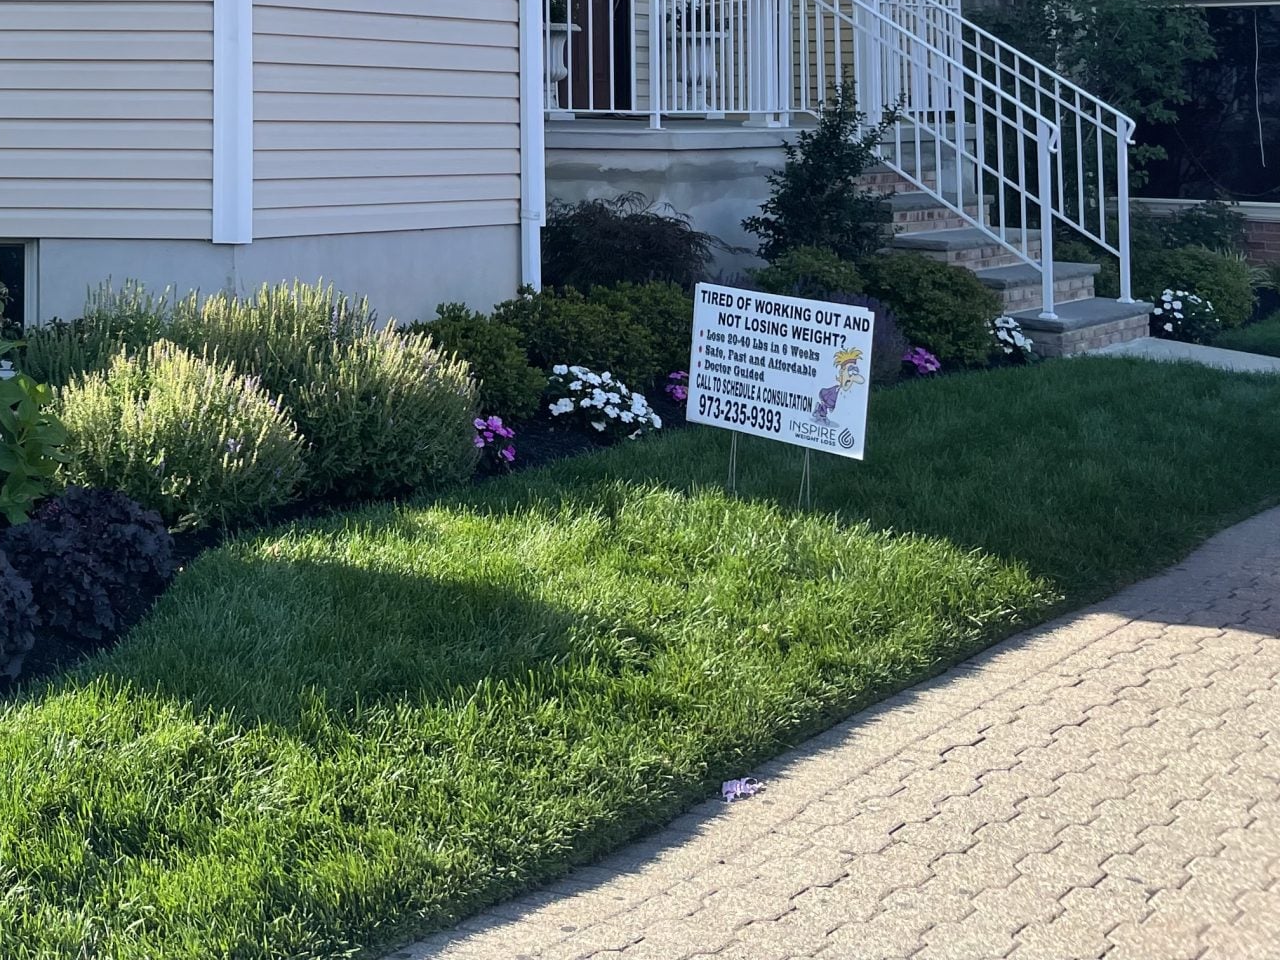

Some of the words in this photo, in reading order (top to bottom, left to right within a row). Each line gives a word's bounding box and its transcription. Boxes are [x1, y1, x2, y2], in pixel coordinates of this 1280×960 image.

[701, 290, 732, 307] TIRED
[737, 296, 751, 310] OF
[755, 299, 811, 321] WORKING
[815, 310, 841, 327] OUT
[843, 316, 870, 332] AND
[707, 330, 725, 343] Lose
[727, 334, 750, 347] 20-40
[753, 338, 767, 351] Lbs
[770, 341, 779, 353] in
[782, 344, 787, 355] 6
[791, 346, 820, 361] Weeks
[718, 312, 741, 328] NOT
[745, 317, 787, 337] LOSING
[792, 325, 846, 348] WEIGHT?
[704, 360, 731, 376] Doctor
[734, 366, 765, 382] Guided
[705, 345, 725, 360] Safe,
[728, 350, 746, 362] Fast
[749, 354, 765, 367] and
[768, 359, 816, 378] Affordable
[696, 373, 712, 390] CALL
[713, 377, 721, 392] TO
[722, 379, 755, 400] SCHEDULE
[756, 388, 761, 401] A
[762, 389, 812, 413] CONSULTATION
[699, 394, 781, 432] 973-235-9393
[789, 420, 837, 440] INSPIRE
[795, 433, 819, 442] WEIGHT
[821, 438, 836, 446] LOSS
